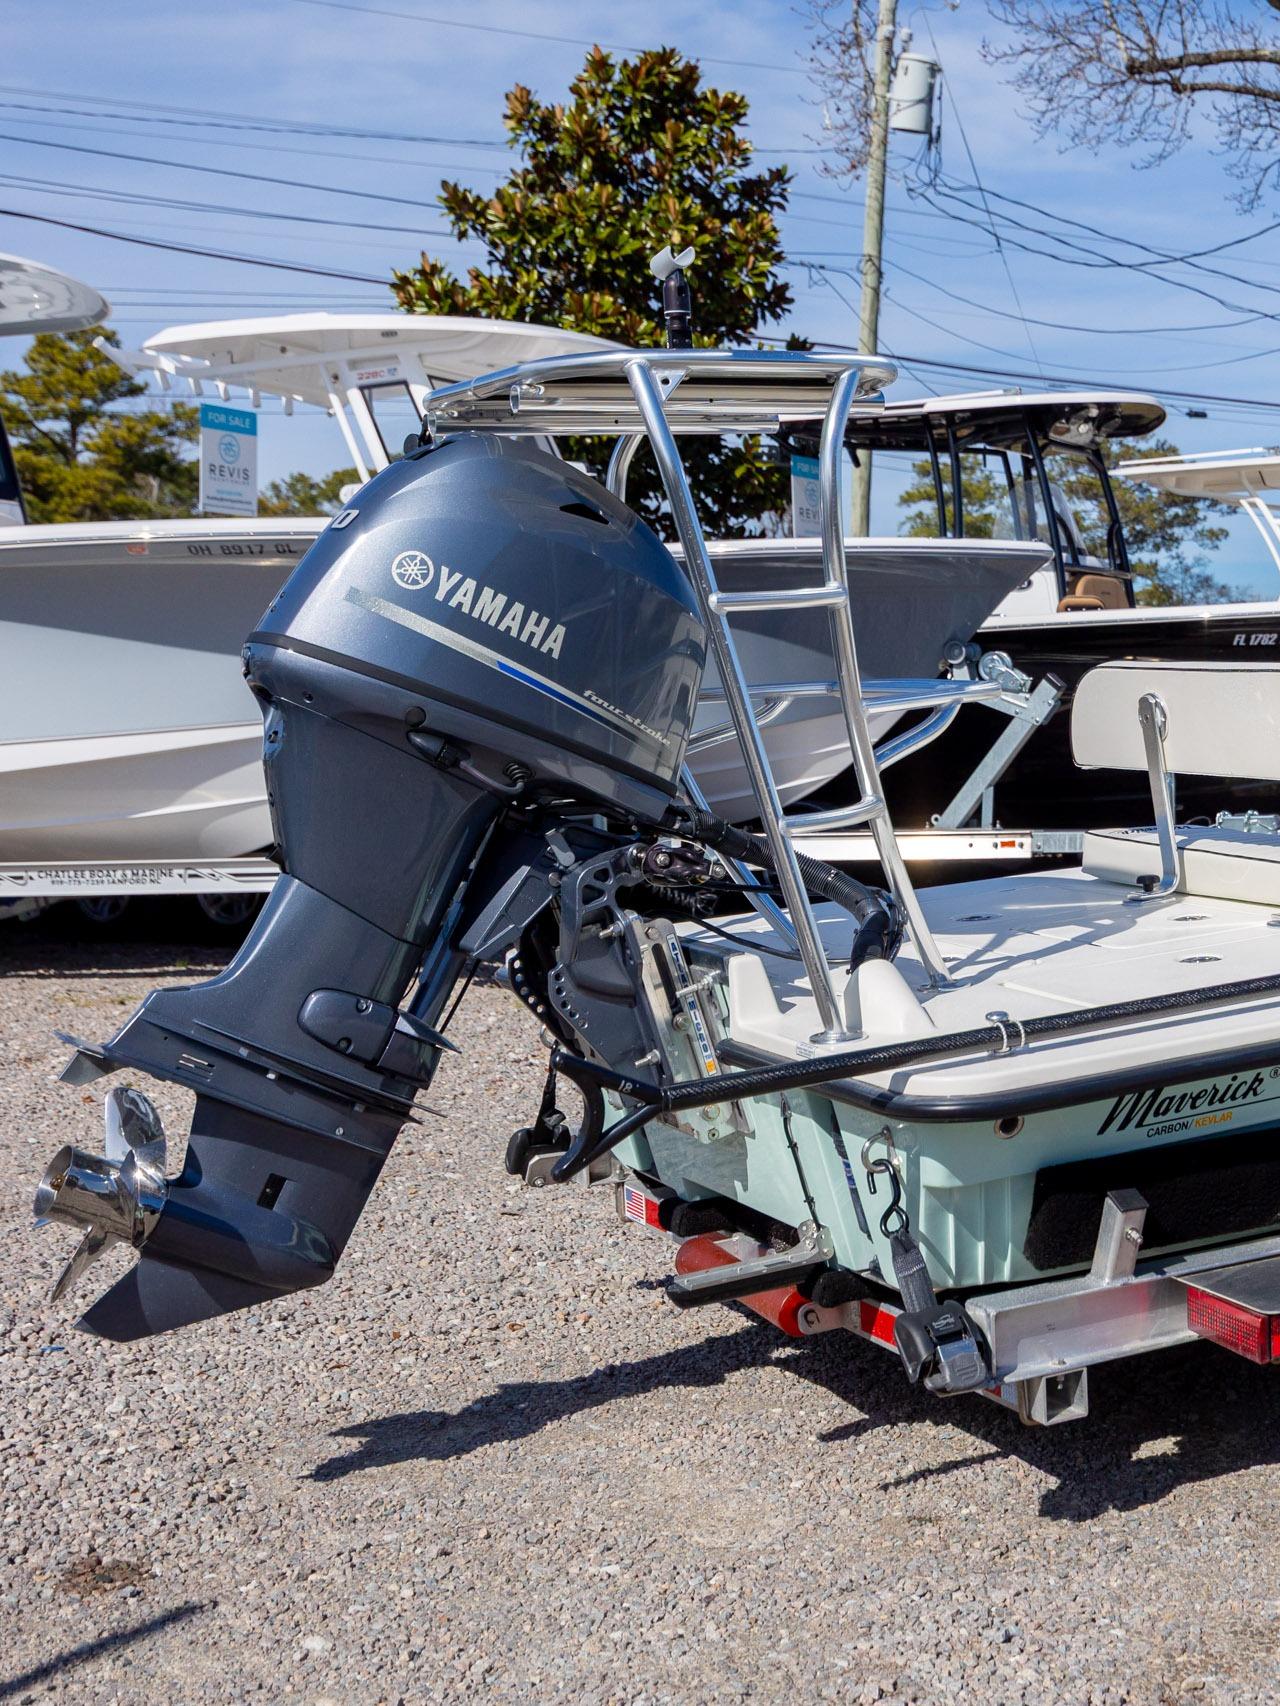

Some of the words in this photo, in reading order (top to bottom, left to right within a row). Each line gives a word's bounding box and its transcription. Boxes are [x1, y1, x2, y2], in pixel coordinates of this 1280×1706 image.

[207, 412, 227, 424] FOR
[229, 415, 251, 429] SALE
[208, 463, 250, 481] REVIS
[187, 544, 213, 556] OH
[222, 544, 265, 556] 8917
[433, 565, 567, 661] YAMAHA
[1232, 633, 1246, 646] FL
[1249, 633, 1278, 646] 1782
[38, 869, 86, 879] CHATLEE
[89, 869, 117, 879] BOAT
[120, 870, 128, 878] &
[130, 868, 174, 879] MARINE
[687, 999, 711, 1058] MICRO
[1097, 1071, 1266, 1136] Maverick
